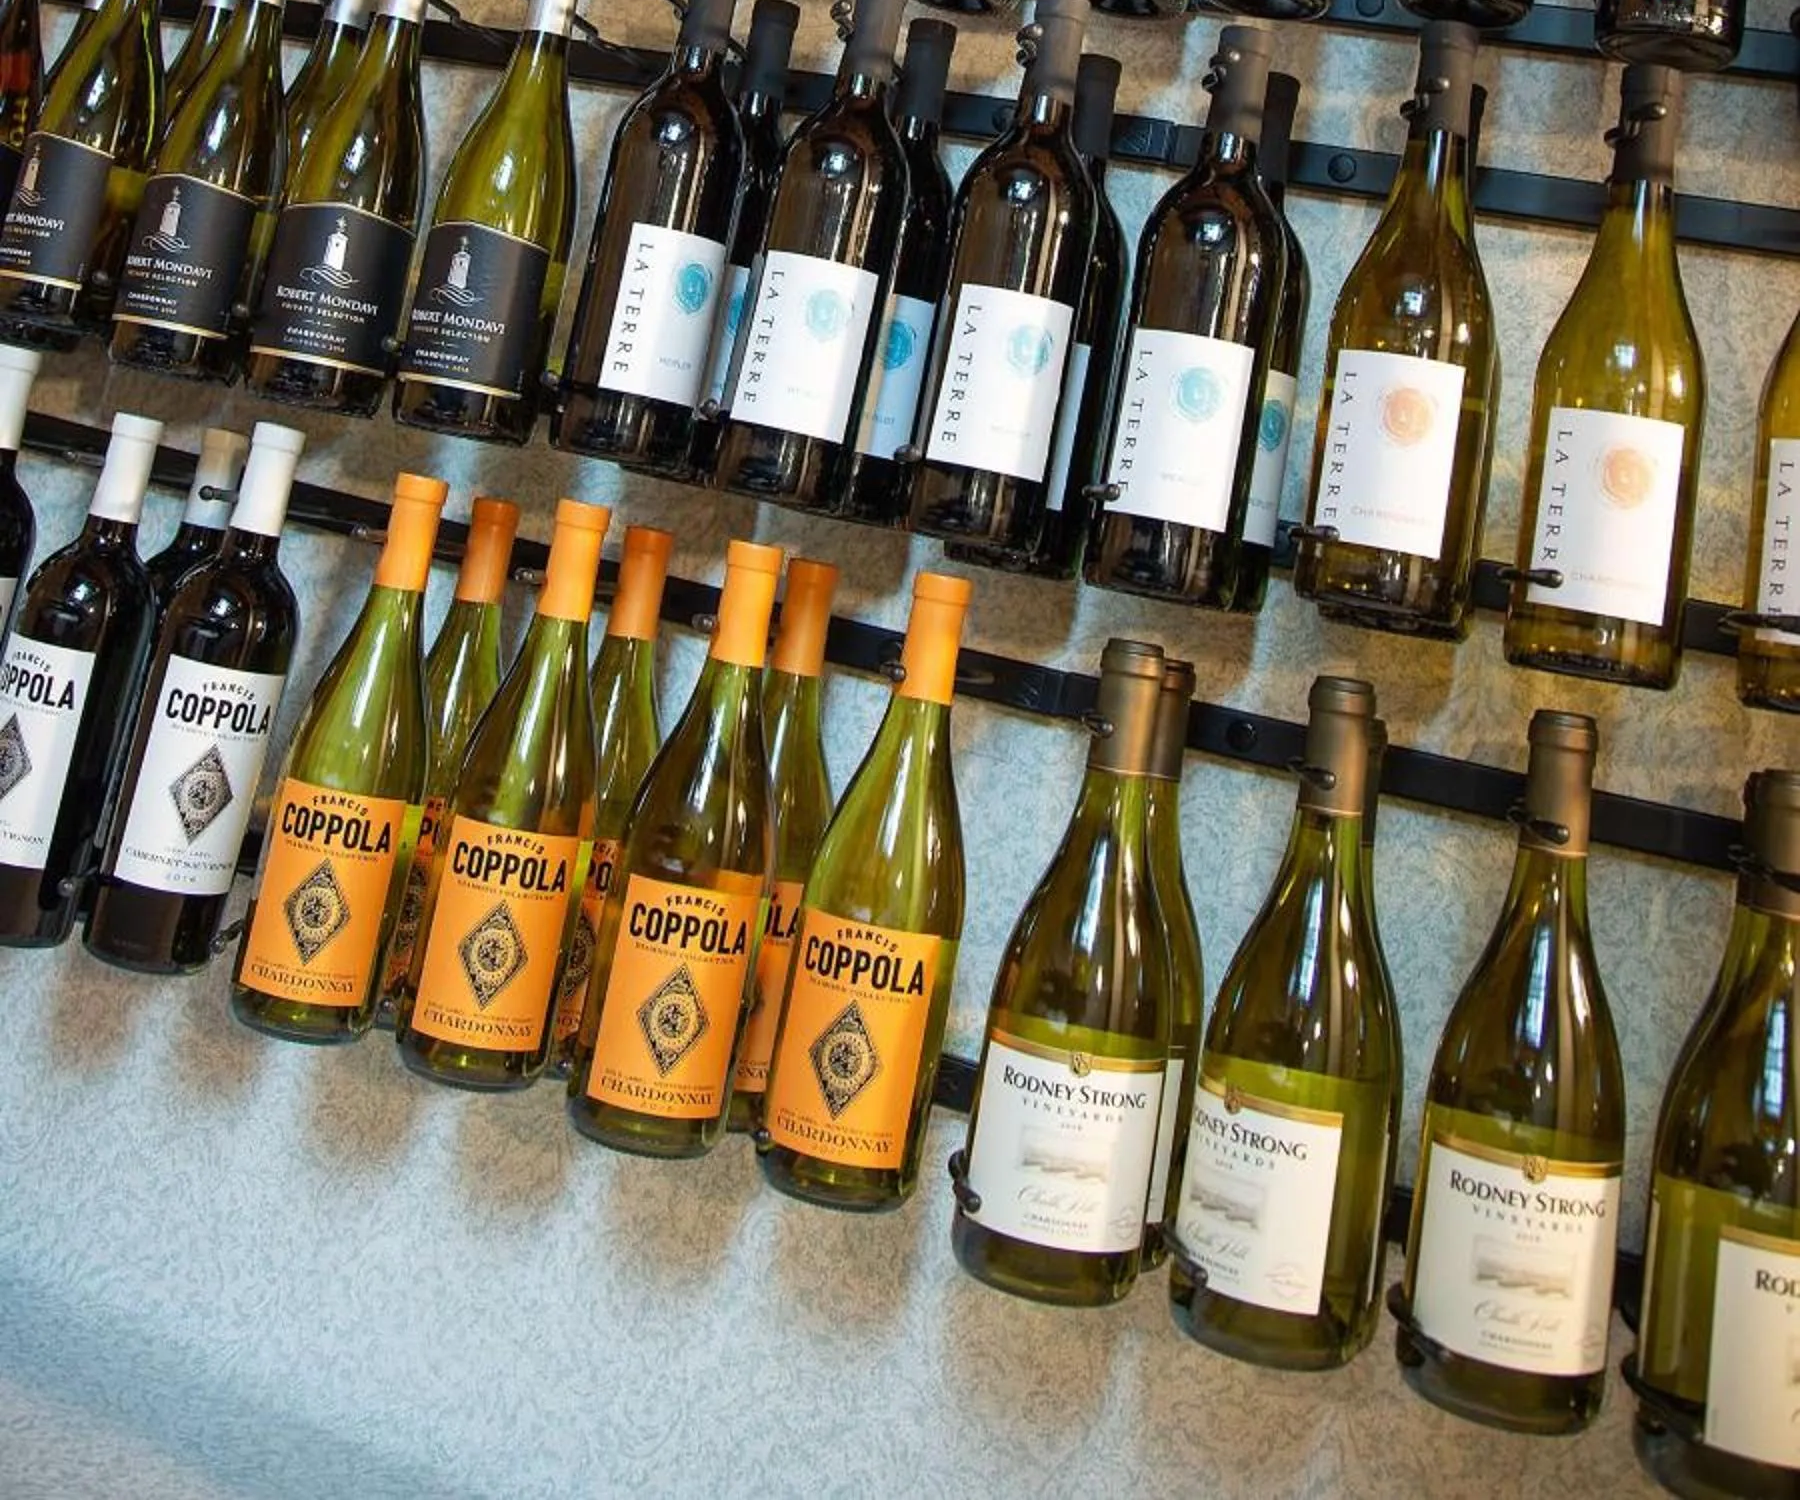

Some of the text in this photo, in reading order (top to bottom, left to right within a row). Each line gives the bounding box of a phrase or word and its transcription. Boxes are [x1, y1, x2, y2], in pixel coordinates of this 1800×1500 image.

[153, 258, 213, 280] MONDAVI
[318, 292, 379, 317] MONDAVI
[442, 312, 506, 336] MONDAVI
[613, 243, 654, 373] LA TERRE
[743, 270, 785, 403] LA TERRE
[940, 304, 984, 445] LA TERRE
[1134, 350, 1154, 382] LA
[1321, 371, 1359, 521] LA TERRE
[1540, 429, 1573, 563] LA TERR
[1766, 460, 1795, 614] LA TERR
[202, 681, 256, 701] FRANCIS
[165, 687, 272, 735] COPPOLA
[312, 795, 369, 817] FRANCIS
[281, 802, 391, 853] COPPOLA
[487, 831, 545, 856] FRANCIS
[452, 841, 568, 894] COPPOLA
[664, 894, 726, 917] FRANCIS
[629, 902, 747, 956] COPPOLA
[836, 928, 899, 954] FRANCIS
[251, 962, 354, 993] CHARDONNAY
[804, 934, 925, 997] COPPOLA
[423, 1008, 532, 1037] CHARDONNAY
[600, 1075, 714, 1106] CHARDONNAY
[1003, 1063, 1147, 1110] RODNEY STRONG
[1021, 1097, 1125, 1124] VINEYARDS
[777, 1115, 893, 1154] CHARDONNAY
[1230, 1121, 1308, 1161] STRONG
[1450, 1169, 1607, 1219] RODNEY STRONG
[1473, 1203, 1584, 1234] VINEYARDS
